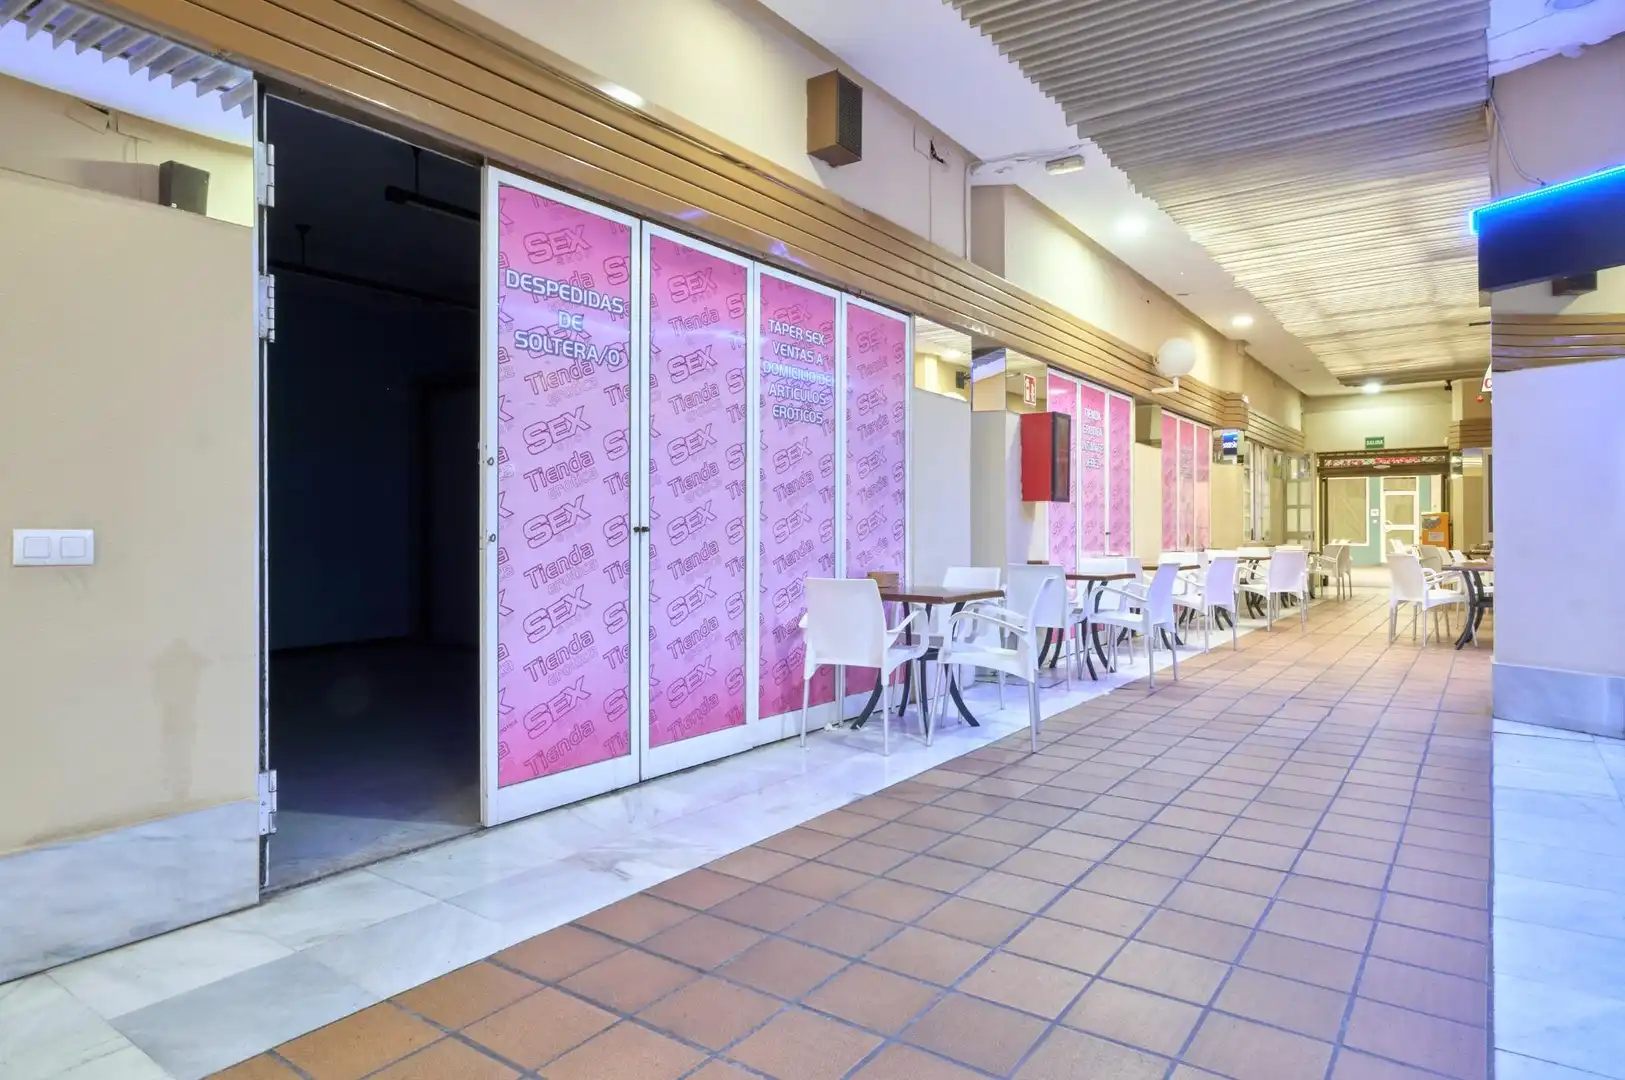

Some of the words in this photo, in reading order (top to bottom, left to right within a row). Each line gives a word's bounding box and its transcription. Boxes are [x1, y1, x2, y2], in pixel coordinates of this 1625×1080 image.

[523, 225, 592, 264] SEX
[505, 268, 624, 314] DESPEDIDAS
[667, 267, 717, 303] SEX
[558, 310, 584, 331] DE
[767, 319, 803, 341] TAPER
[666, 345, 718, 384] SEX
[762, 360, 817, 382] DOMICILIO
[818, 371, 834, 386] DE
[772, 341, 814, 363] VENTAS
[816, 353, 824, 366] A
[668, 382, 720, 415] Tienda
[856, 384, 887, 416] SEX
[523, 405, 592, 455] SEX
[667, 422, 718, 466] SEX
[523, 451, 595, 492] Tienda
[773, 436, 812, 474] SEX
[856, 445, 887, 480] SEX
[667, 461, 720, 498] Tienda
[773, 470, 814, 502] Tienda
[523, 494, 592, 549] SEX
[667, 499, 718, 546] SEX
[773, 503, 812, 544] SEX
[856, 505, 887, 541] SEX
[523, 542, 595, 589] Tienda
[667, 540, 720, 581] Tienda
[773, 539, 814, 574] Tienda
[523, 584, 592, 644] SEX
[666, 576, 718, 627] SEX
[523, 630, 595, 682] Tienda
[666, 616, 720, 660] Tienda
[666, 654, 718, 709] SEX
[523, 675, 592, 740] SEX
[667, 693, 720, 741] Tienda
[524, 719, 595, 776] Tienda
